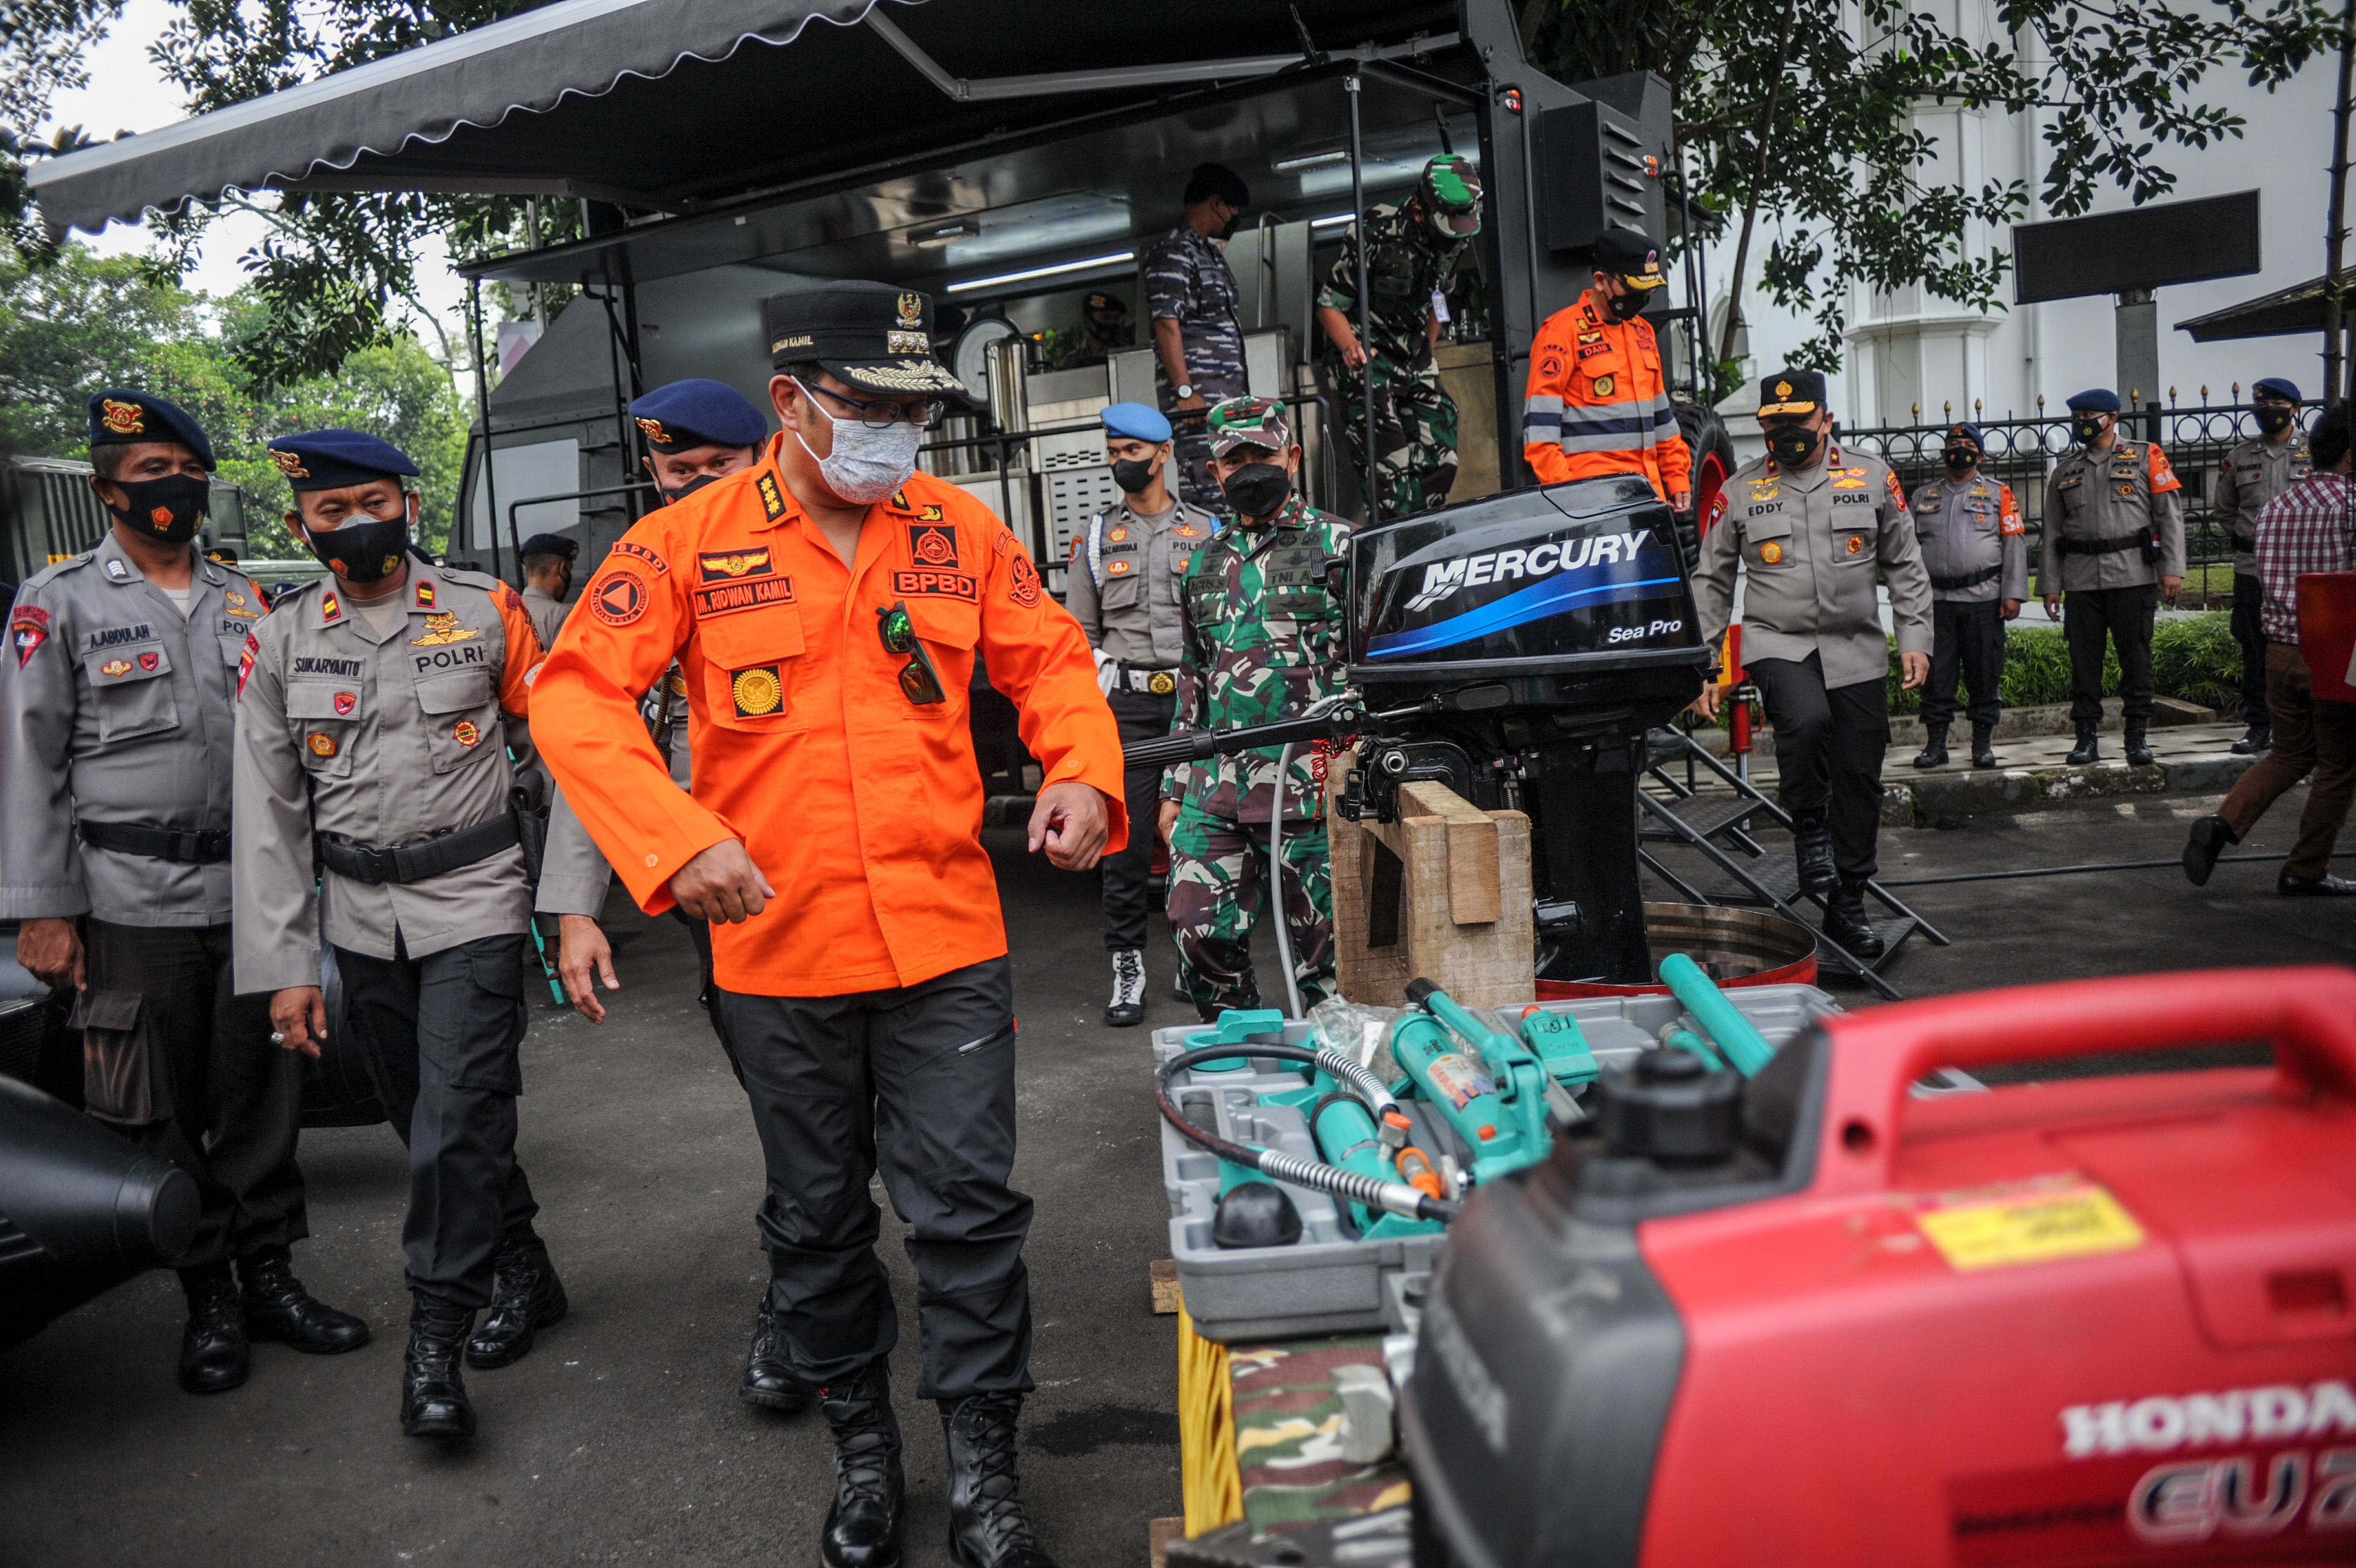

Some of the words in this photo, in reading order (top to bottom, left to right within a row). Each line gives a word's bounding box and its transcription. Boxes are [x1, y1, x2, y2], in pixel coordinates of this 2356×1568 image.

[789, 335, 813, 347] KAMIL
[1584, 343, 1608, 357] DANI
[1748, 502, 1783, 517] EDDY
[1833, 494, 1869, 505] POLRI
[617, 544, 663, 569] BPBD
[1422, 530, 1650, 596] MERCURY
[898, 573, 974, 596] BPBD
[1270, 571, 1293, 584] TNI
[755, 580, 791, 602] KAMIL
[593, 593, 637, 623] INDONESIA
[1608, 626, 1645, 643] Sea
[1649, 619, 1682, 636] Pro
[294, 657, 360, 677] SUKARYANTO
[415, 646, 484, 673] POLRI
[2058, 1381, 2356, 1461] HONDA
